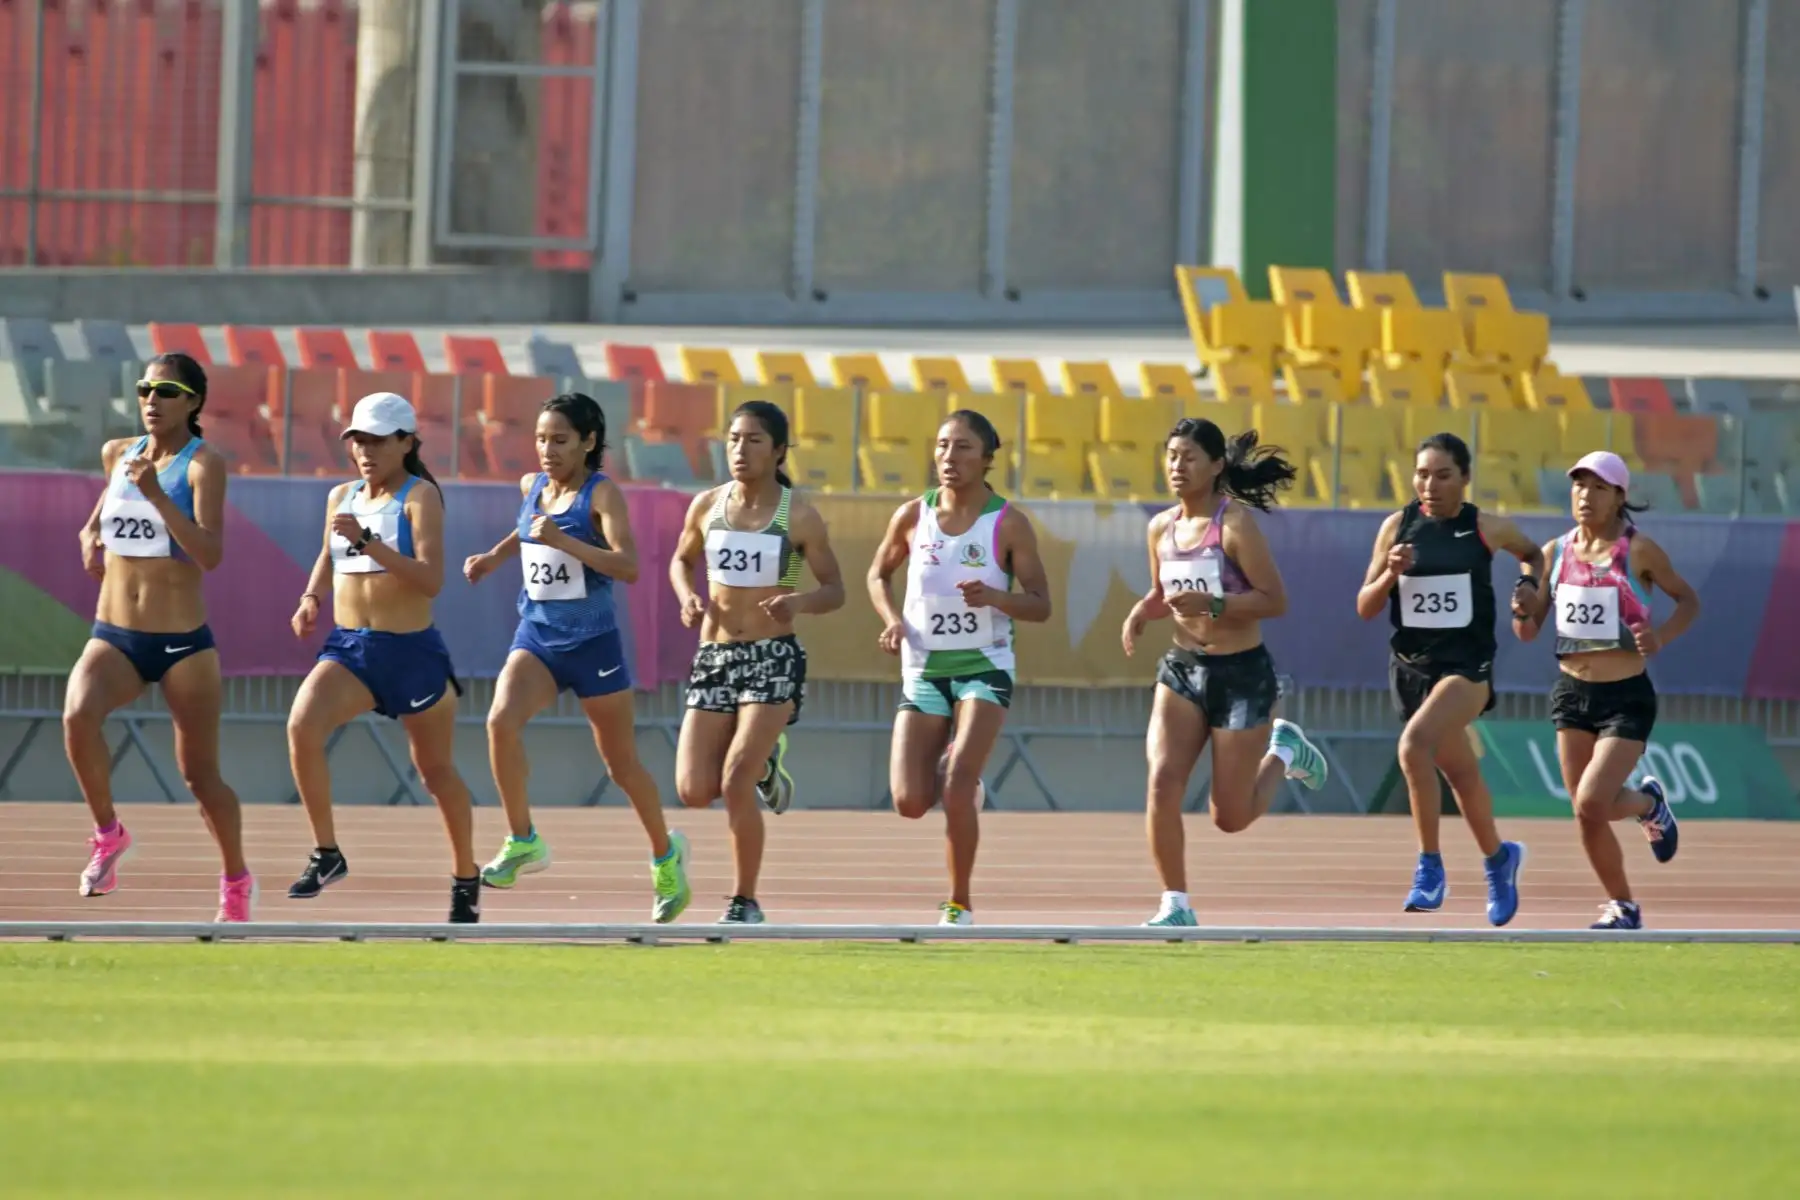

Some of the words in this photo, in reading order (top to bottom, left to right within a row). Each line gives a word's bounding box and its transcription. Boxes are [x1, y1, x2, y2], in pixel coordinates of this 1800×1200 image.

[113, 517, 156, 540] 228
[718, 548, 761, 573] 231
[529, 561, 570, 585] 234
[1412, 591, 1458, 614] 235
[1566, 602, 1605, 625] 232
[930, 612, 978, 635] 233
